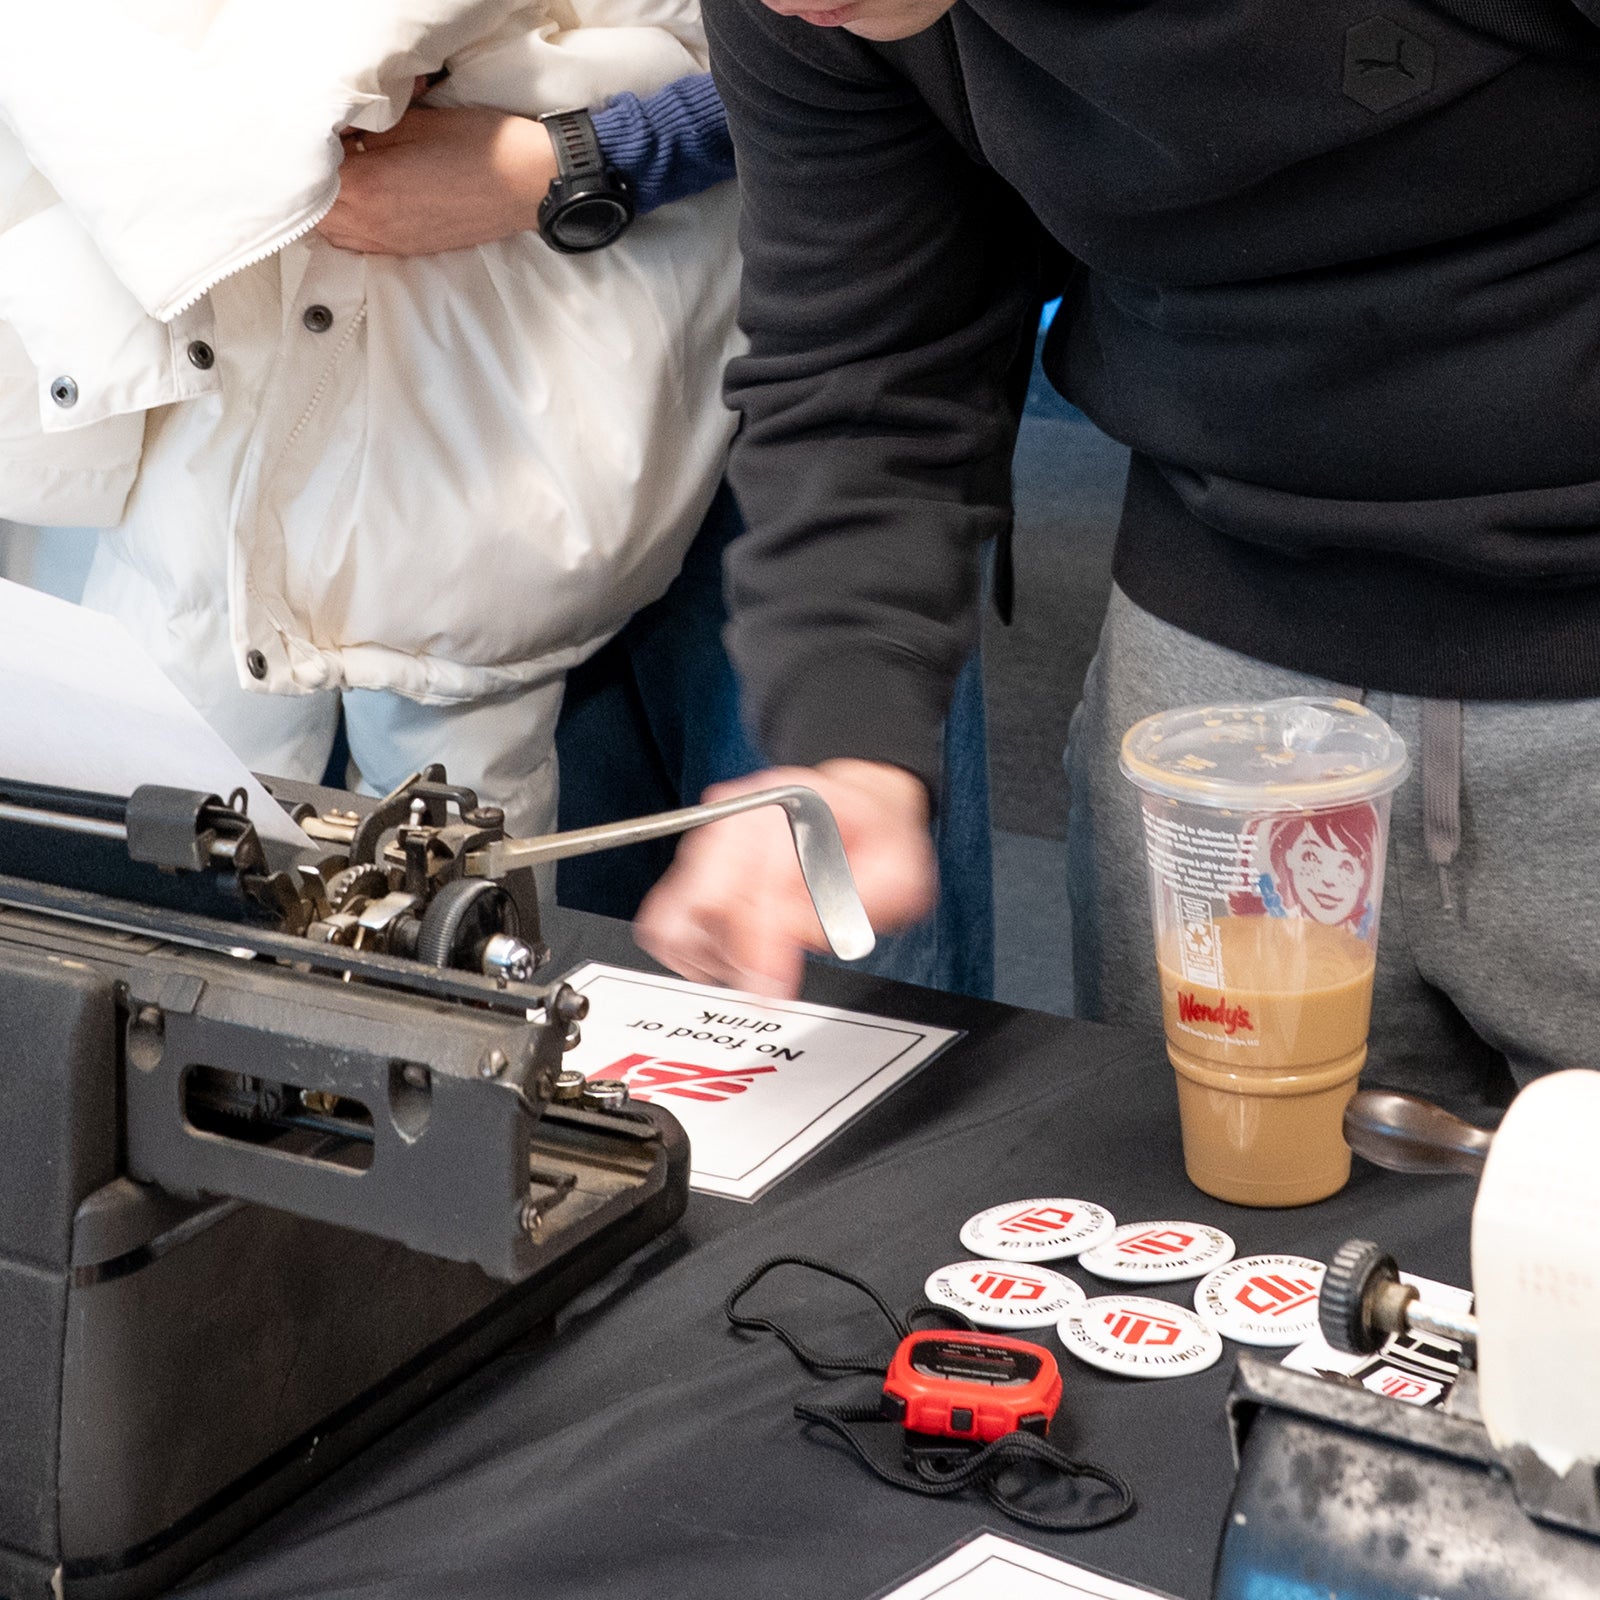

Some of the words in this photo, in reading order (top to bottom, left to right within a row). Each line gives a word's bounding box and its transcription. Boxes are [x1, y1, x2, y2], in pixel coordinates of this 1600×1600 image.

[626, 1019, 661, 1031] or
[698, 1009, 782, 1033] drink
[667, 1027, 748, 1050] food
[755, 1041, 806, 1063] No
[997, 1236, 1072, 1249] MUSEUM
[1114, 1258, 1189, 1270] MUSEUM
[1205, 1264, 1247, 1317] COMPUTER
[1247, 1257, 1323, 1274] MUSEUM
[979, 1298, 1071, 1316] COMPUTER
[1113, 1344, 1206, 1365] COMPUTER
